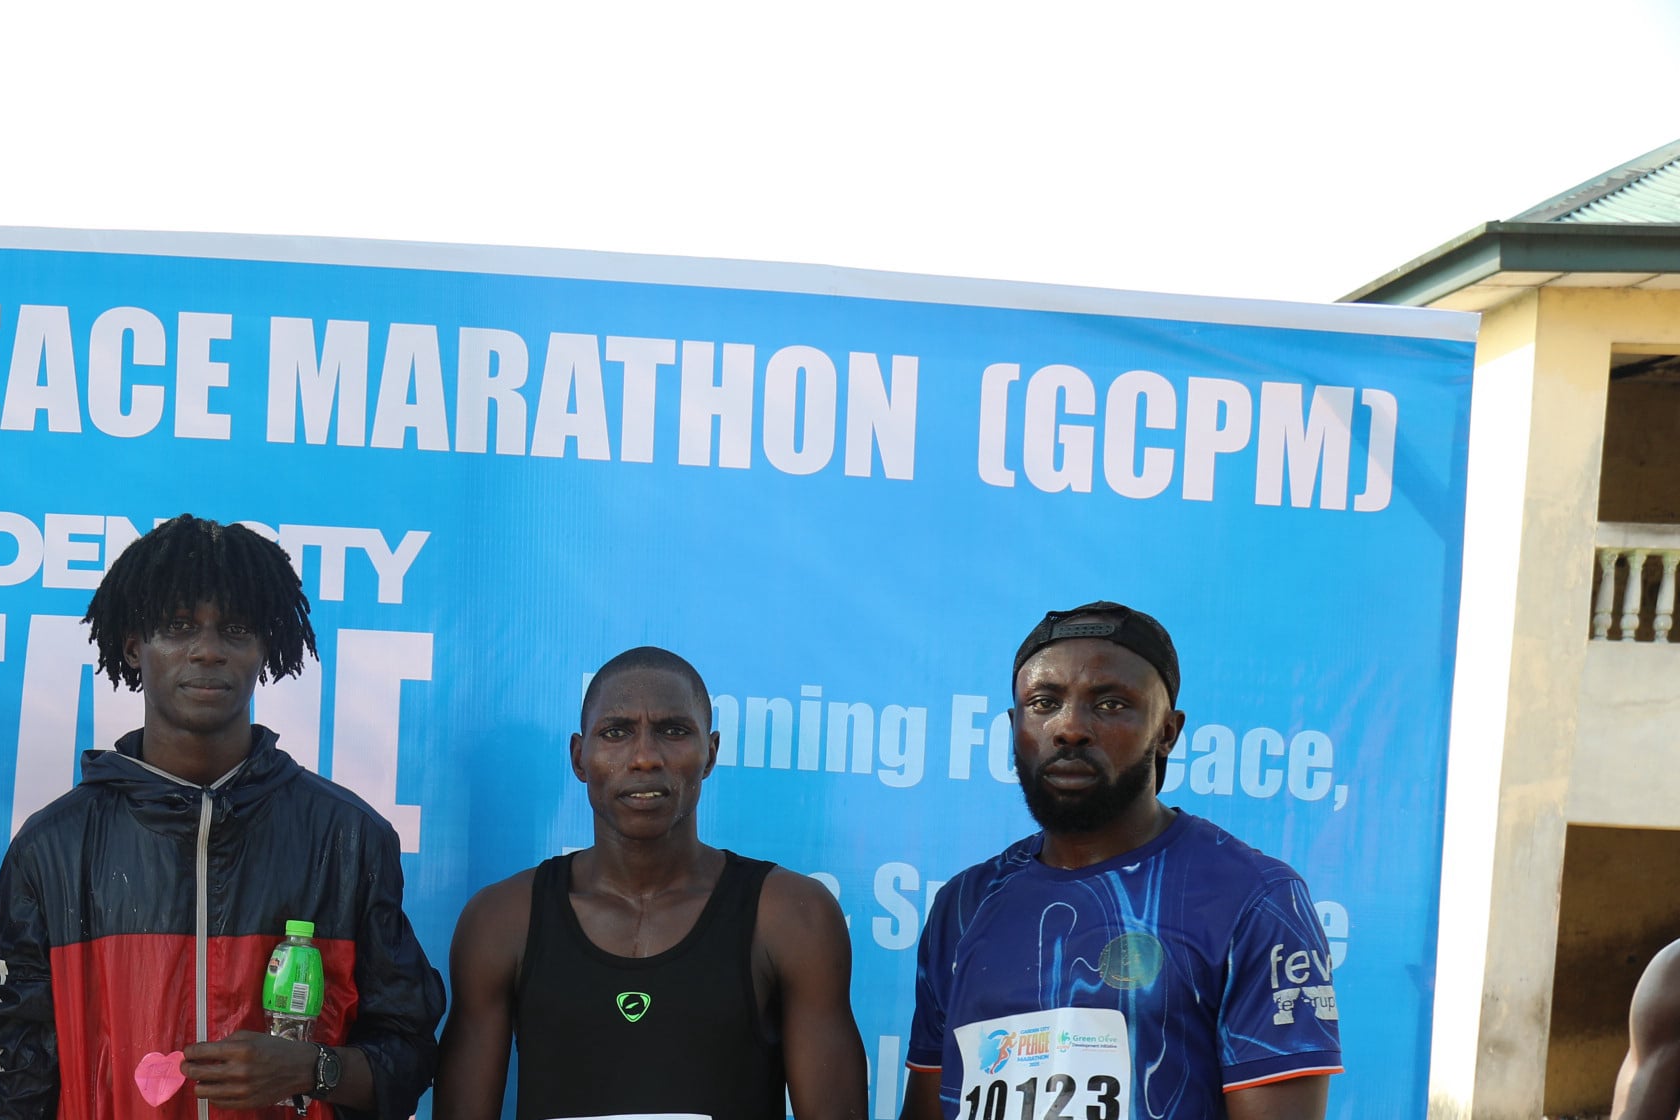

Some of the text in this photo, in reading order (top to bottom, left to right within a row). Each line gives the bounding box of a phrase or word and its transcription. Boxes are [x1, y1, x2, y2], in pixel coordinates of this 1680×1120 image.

[266, 316, 919, 481] MARATHON
[978, 362, 1397, 512] (GCPM)
[1018, 1031, 1051, 1056] PEACE
[1098, 1033, 1117, 1043] Olive
